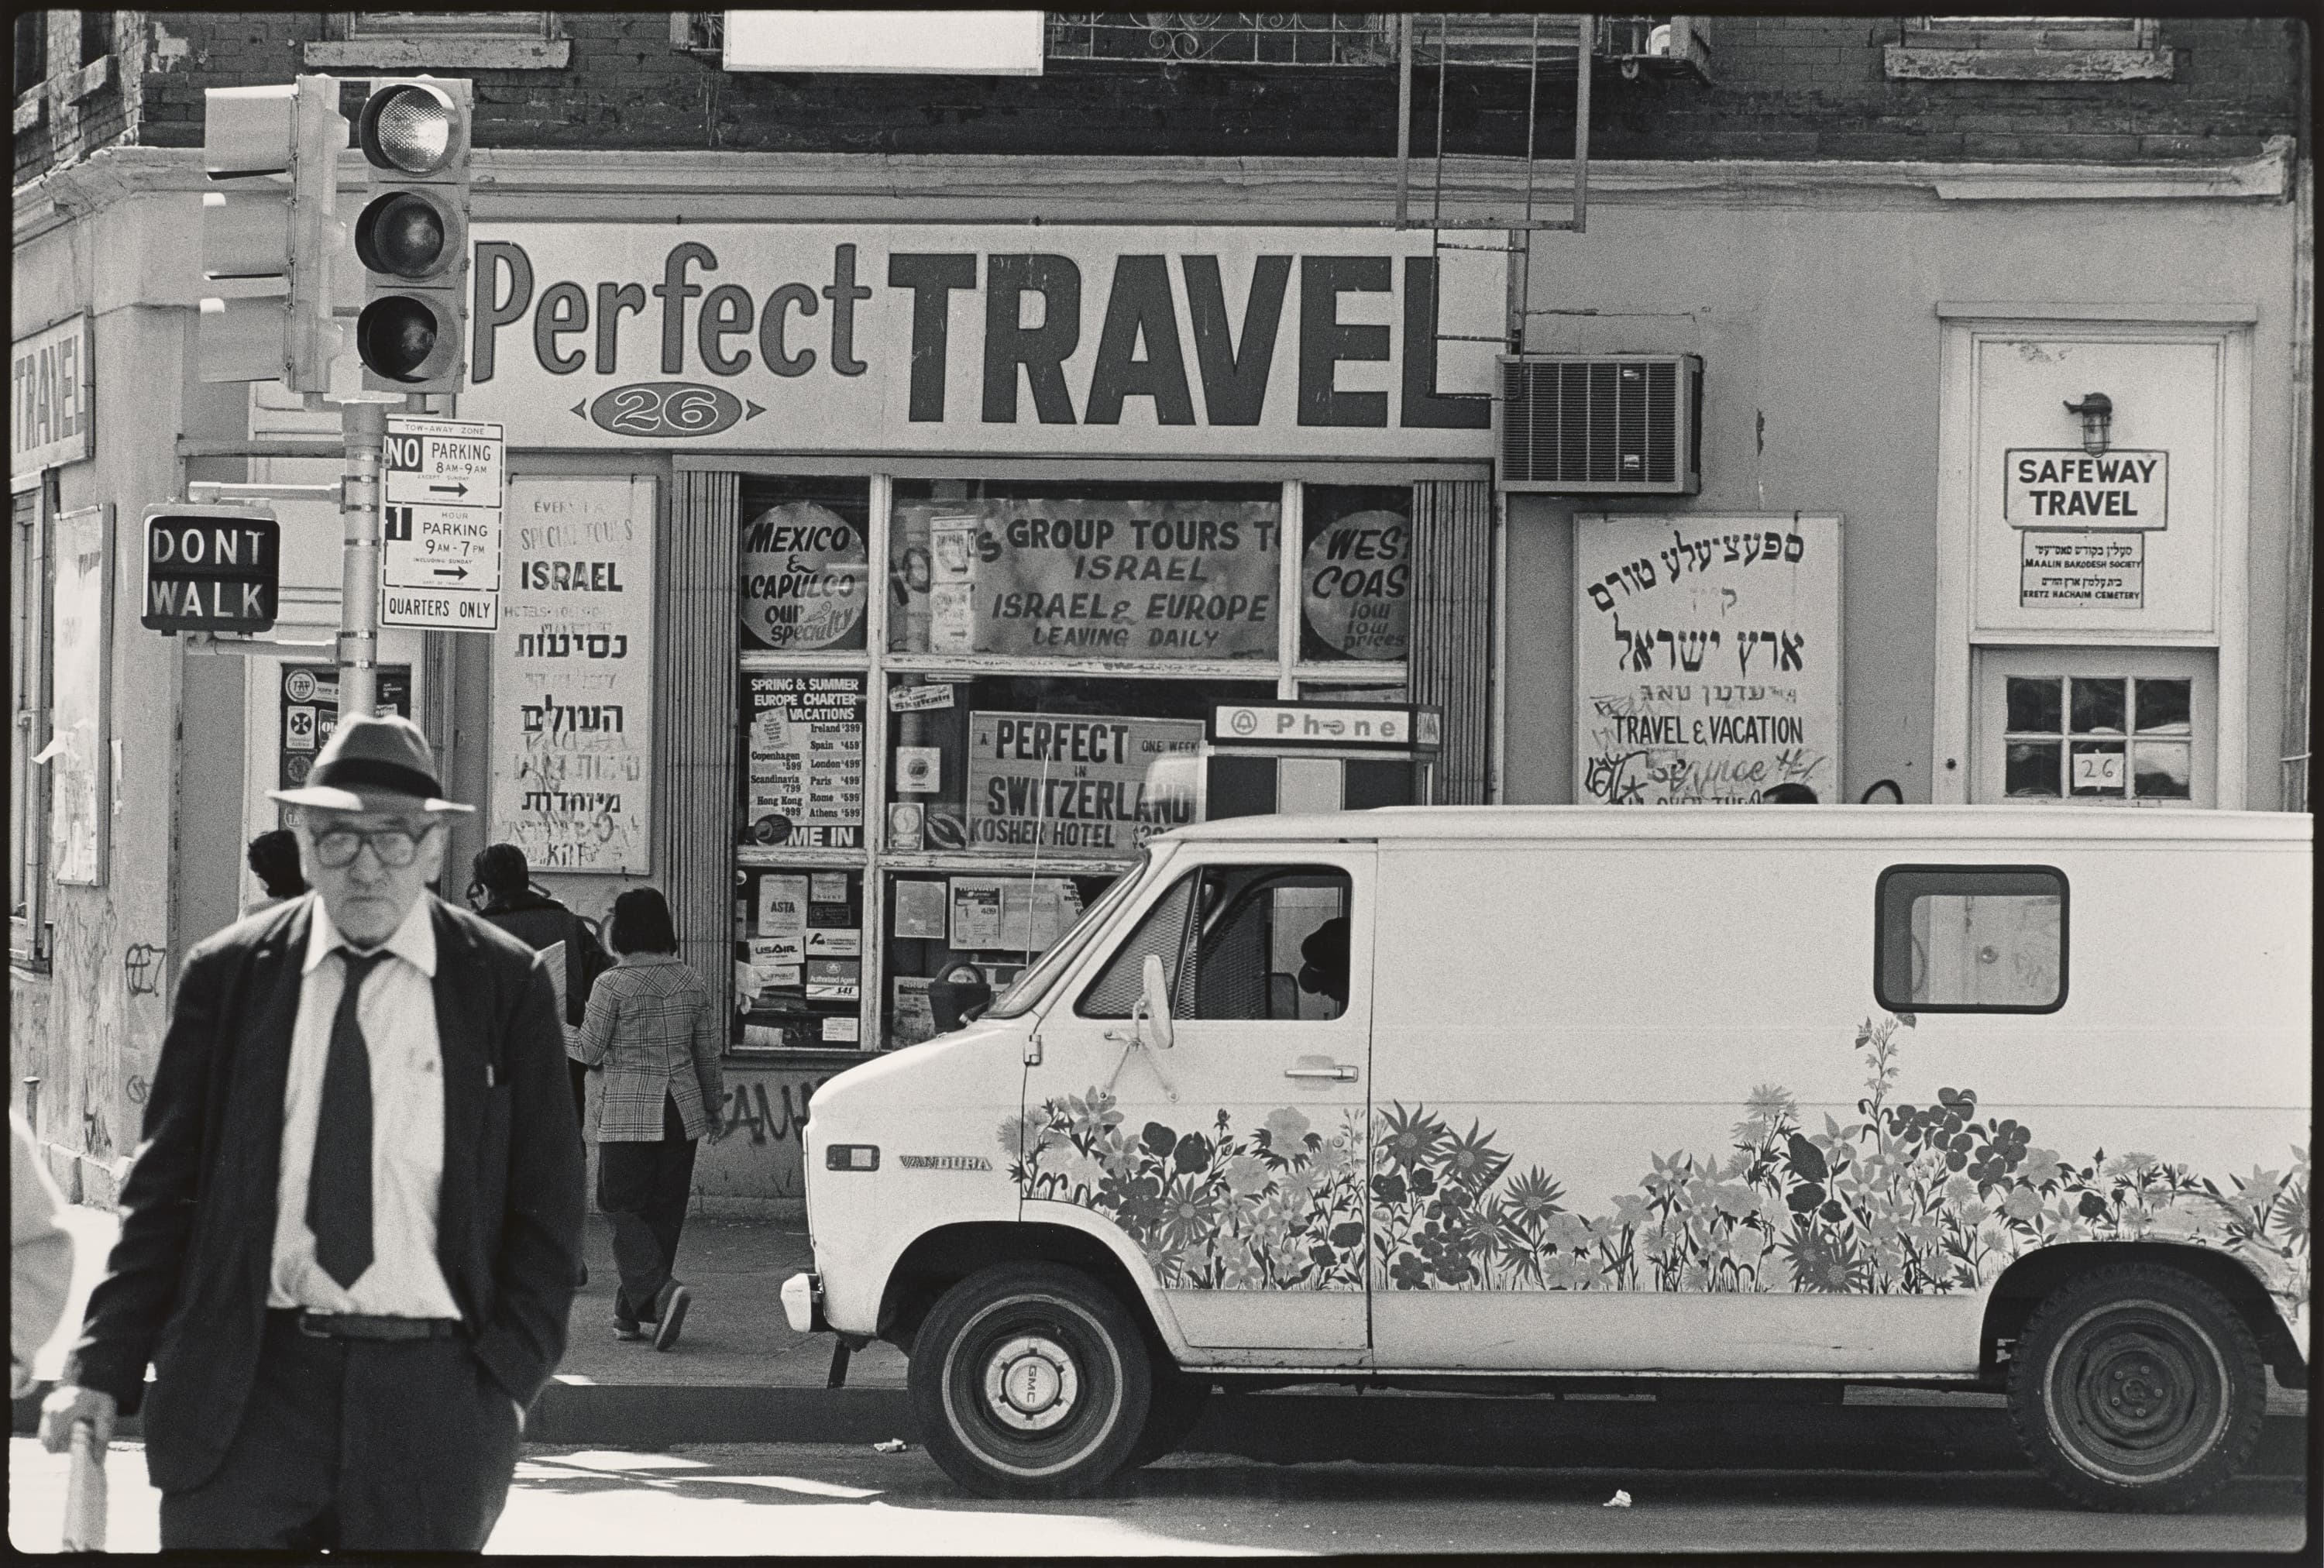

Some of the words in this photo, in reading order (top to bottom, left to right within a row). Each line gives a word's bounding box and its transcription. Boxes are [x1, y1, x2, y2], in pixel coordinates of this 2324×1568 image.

[472, 240, 872, 384] Perfect
[889, 253, 1492, 428] TRAVEL
[14, 335, 84, 453] TRAVEL
[613, 389, 719, 430] 26
[405, 424, 453, 432] TOW-AWAY
[388, 438, 419, 467] NO
[431, 442, 491, 461] PARKING
[2019, 459, 2157, 483] SAFEWAY
[2029, 490, 2138, 516] TRAVEL
[423, 522, 488, 537] PARKING
[747, 522, 851, 553] MEXICO
[1007, 518, 1115, 549] GROUP
[1129, 521, 1239, 551] TOURS
[153, 528, 265, 565] DONT
[786, 554, 816, 573] &
[1074, 555, 1208, 582] ISRAEL
[2025, 559, 2061, 568] MAALIN
[521, 561, 623, 592] ISRAEL
[152, 581, 263, 618] WALK
[2053, 590, 2092, 599] HACHAIM
[2095, 591, 2140, 600] CEMETERY
[390, 597, 450, 617] QUARTERS
[460, 601, 490, 618] ONLY
[992, 592, 1111, 621] ISRAEL
[1146, 592, 1270, 621] EUROPE
[1033, 627, 1129, 647] LEAVING
[1148, 628, 1219, 648] DAILY
[1614, 611, 1721, 672] ישראל
[1737, 629, 1805, 677] ארץ
[751, 679, 793, 691] SPRING
[796, 679, 806, 690] &
[809, 679, 859, 691] SUMMER
[755, 694, 798, 706] EUROPE
[803, 693, 857, 706] CHARTER
[789, 708, 854, 720] VACATIONS
[811, 724, 840, 733] Ireland
[1613, 716, 1689, 744] TRAVEL
[1709, 716, 1803, 744] VACATION
[810, 741, 834, 751] Spain
[980, 733, 988, 745] A
[996, 720, 1129, 764] PERFECT
[1142, 740, 1163, 752] ONE
[751, 751, 800, 762] Copenhagen
[811, 759, 841, 769] London
[1075, 765, 1086, 778] IN
[2082, 758, 2114, 779] 26
[751, 775, 799, 784] Scandinavia
[810, 776, 832, 786] Paris
[757, 796, 779, 806] Hong
[781, 796, 803, 806] Kong
[810, 793, 834, 802] Rome
[988, 776, 1191, 824] SWITZERLAND
[809, 809, 838, 817] Athens
[830, 827, 854, 847] IN
[971, 817, 1044, 845] KOSHER
[1053, 821, 1116, 848] HOTEL
[771, 902, 795, 913] ASTA
[899, 1155, 993, 1171] VANDURA
[1027, 1365, 1037, 1404] GMC
